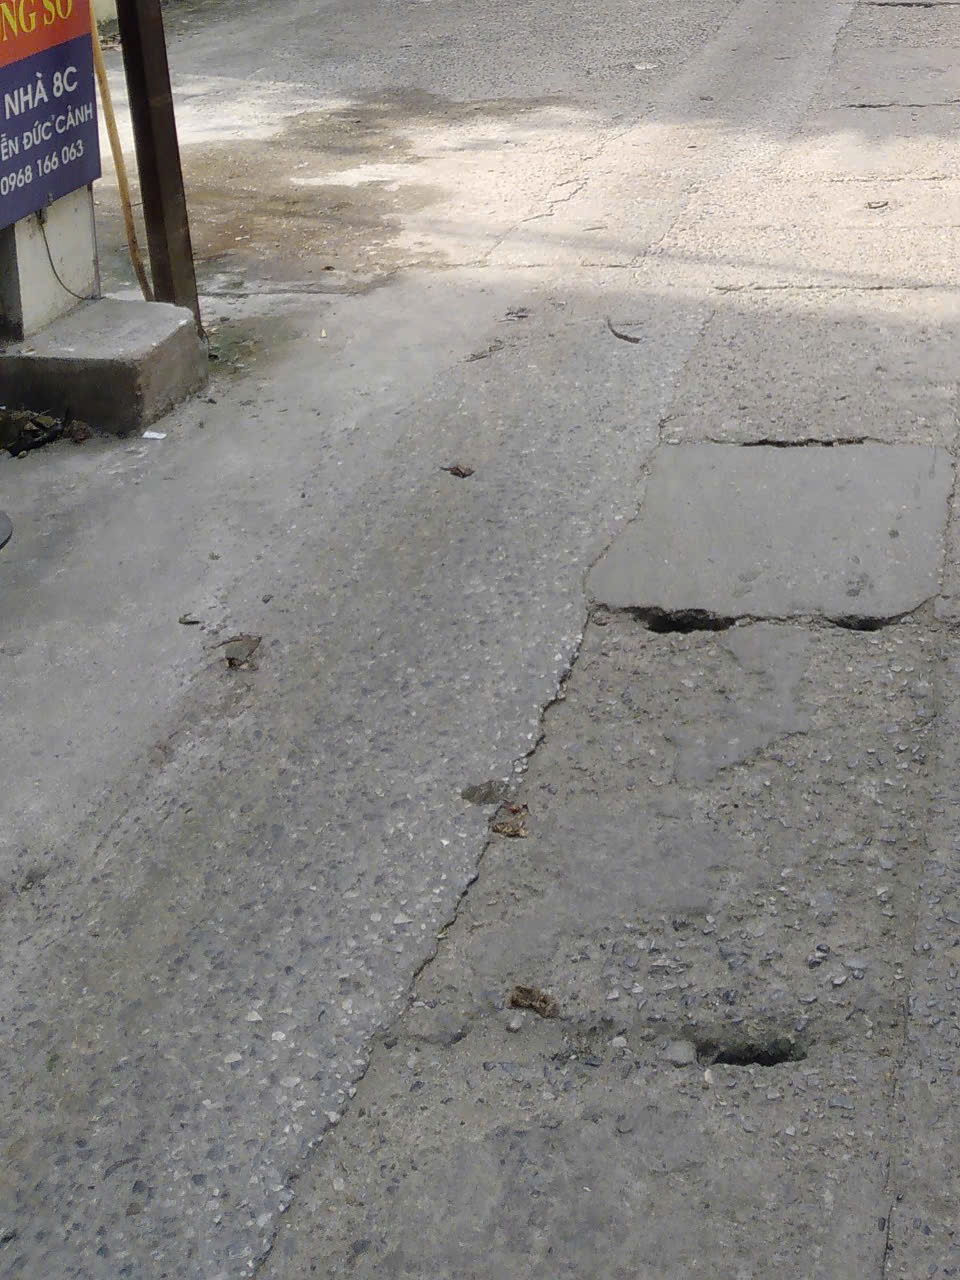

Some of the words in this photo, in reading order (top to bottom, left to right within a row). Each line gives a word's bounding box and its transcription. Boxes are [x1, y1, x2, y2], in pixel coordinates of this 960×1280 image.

[4, 72, 48, 120] NHÀ
[53, 66, 78, 98] 8C
[0, 133, 19, 161] ỄN
[22, 119, 52, 151] ĐỨC
[55, 102, 93, 135] CẢNH
[0, 165, 33, 196] 0968
[37, 153, 59, 177] 166
[61, 139, 84, 165] 063
